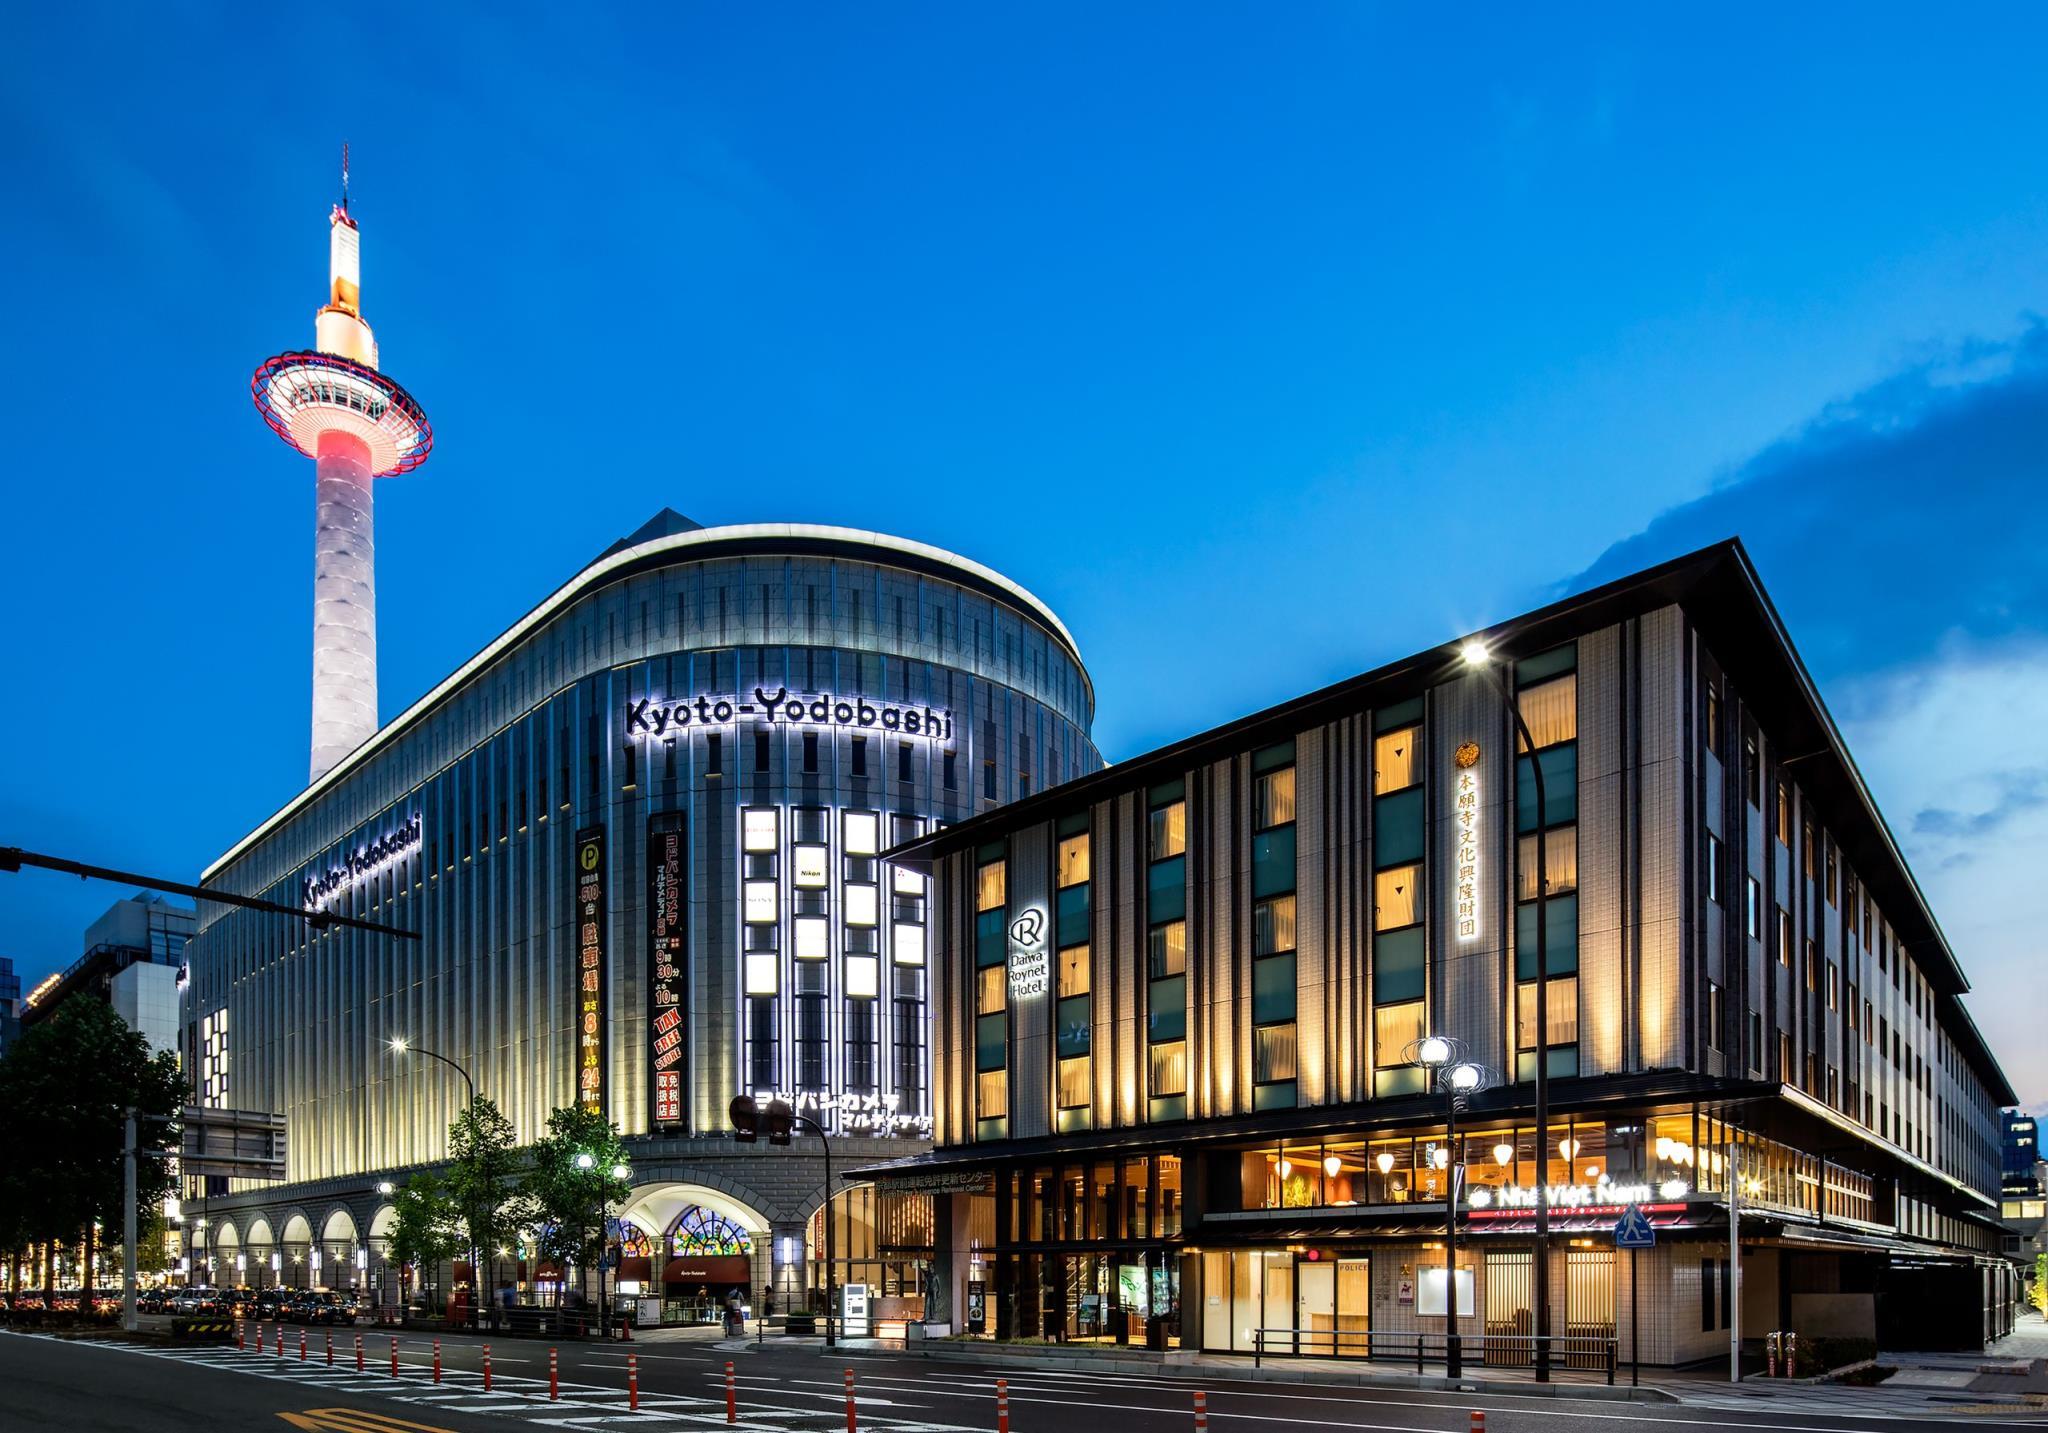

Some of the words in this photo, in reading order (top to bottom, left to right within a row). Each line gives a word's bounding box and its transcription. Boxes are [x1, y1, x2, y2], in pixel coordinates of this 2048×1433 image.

[626, 687, 952, 740] Kyoto-Yodobashi
[302, 812, 421, 909] Kyoto-Yodobashi
[1457, 774, 1476, 937] 本願寺文化興隆財団
[581, 884, 599, 902] 510
[665, 835, 679, 925] ヨドバシカメラ
[583, 922, 598, 991] 駐車場
[1011, 952, 1043, 967] Daiwa
[1009, 964, 1047, 982] Roynet
[1012, 980, 1042, 996] Hotel
[653, 1007, 682, 1034] TAX
[653, 1028, 682, 1055] FREE
[654, 1047, 682, 1071] STORE
[658, 1075, 668, 1117] 取扱店
[669, 1075, 678, 1117] 免税品
[1597, 1183, 1652, 1203] Nam
[1339, 1263, 1368, 1271] POLICE
